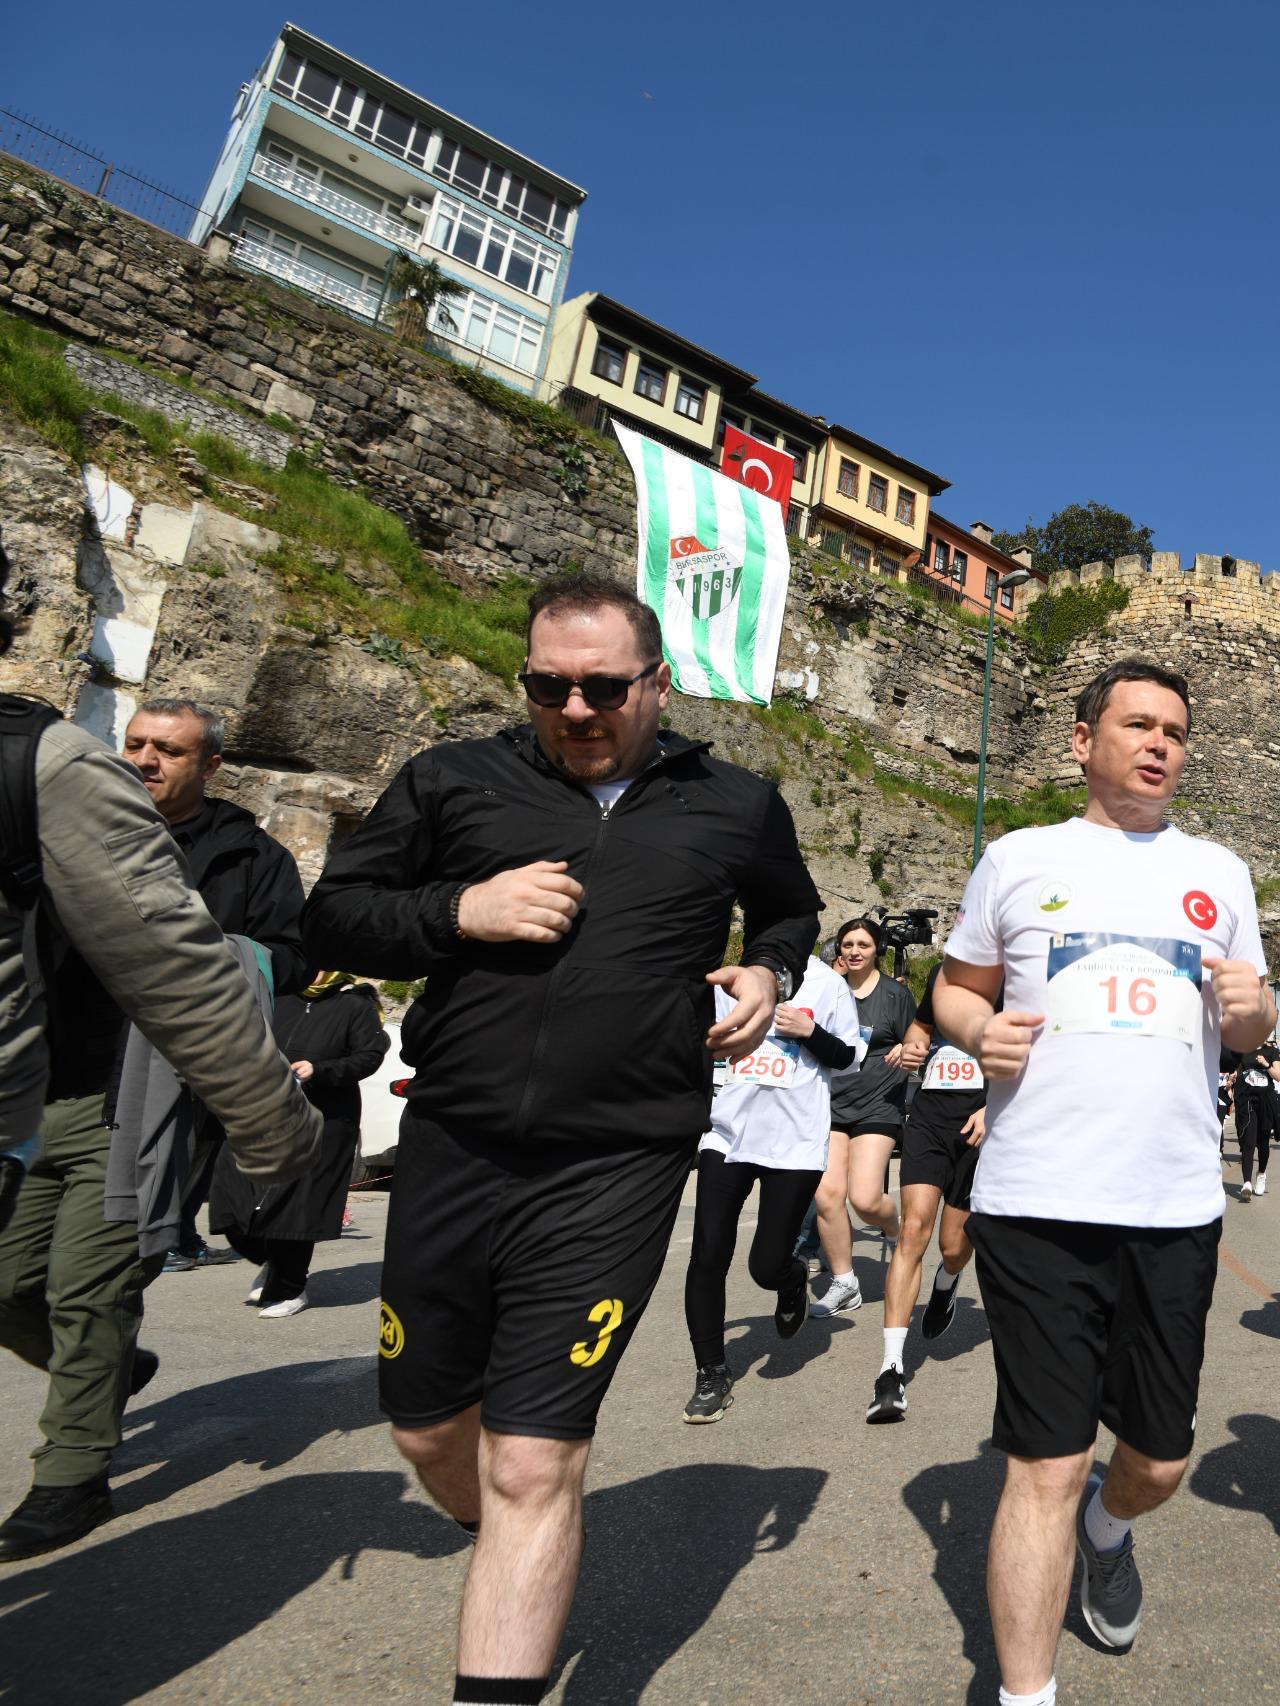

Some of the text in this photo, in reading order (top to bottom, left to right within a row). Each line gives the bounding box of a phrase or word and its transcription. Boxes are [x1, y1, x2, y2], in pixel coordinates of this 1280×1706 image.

[1098, 975, 1157, 1016] 16
[936, 1062, 975, 1081] 199
[569, 1299, 624, 1368] 3
